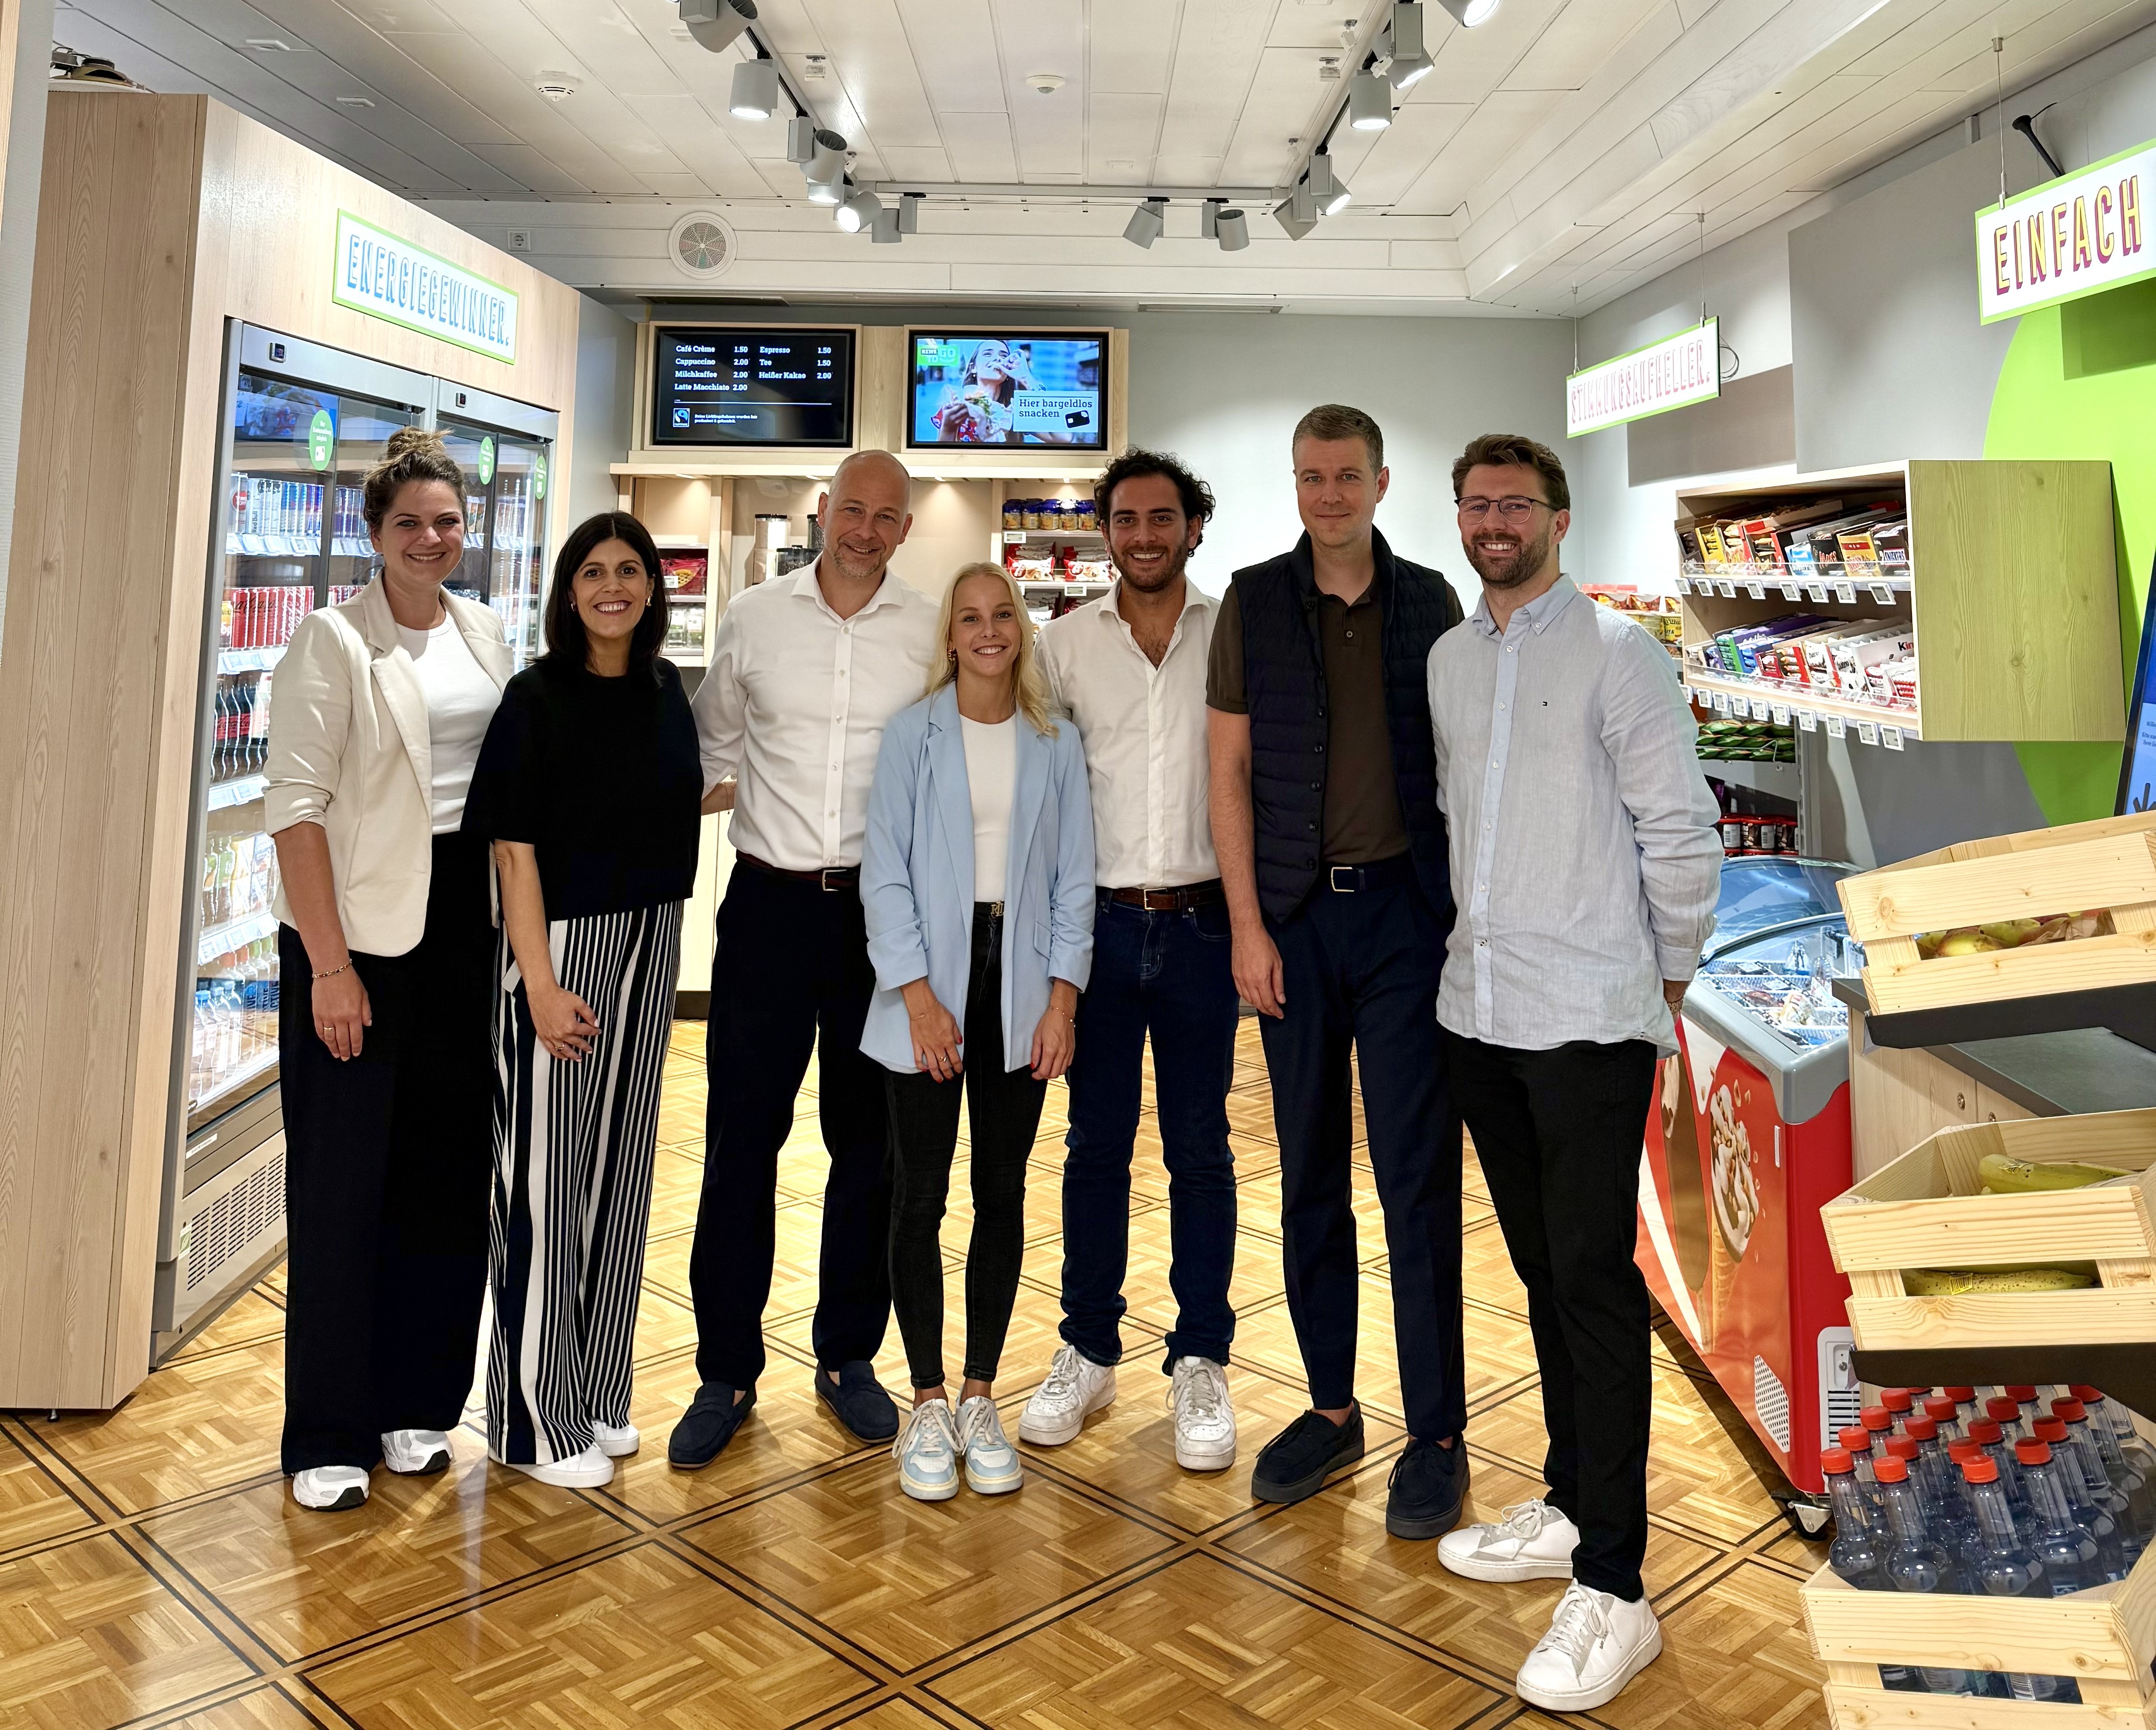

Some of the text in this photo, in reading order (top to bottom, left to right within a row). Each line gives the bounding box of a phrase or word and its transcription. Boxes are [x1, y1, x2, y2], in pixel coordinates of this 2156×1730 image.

[1994, 175, 2141, 295] EINFACH
[347, 234, 509, 346] ENERGIEGEWINNER.
[939, 348, 956, 357] GO
[1043, 399, 1092, 409] bargeldlos
[1019, 409, 1059, 417] snacken
[1884, 551, 1905, 562] SNICKERS
